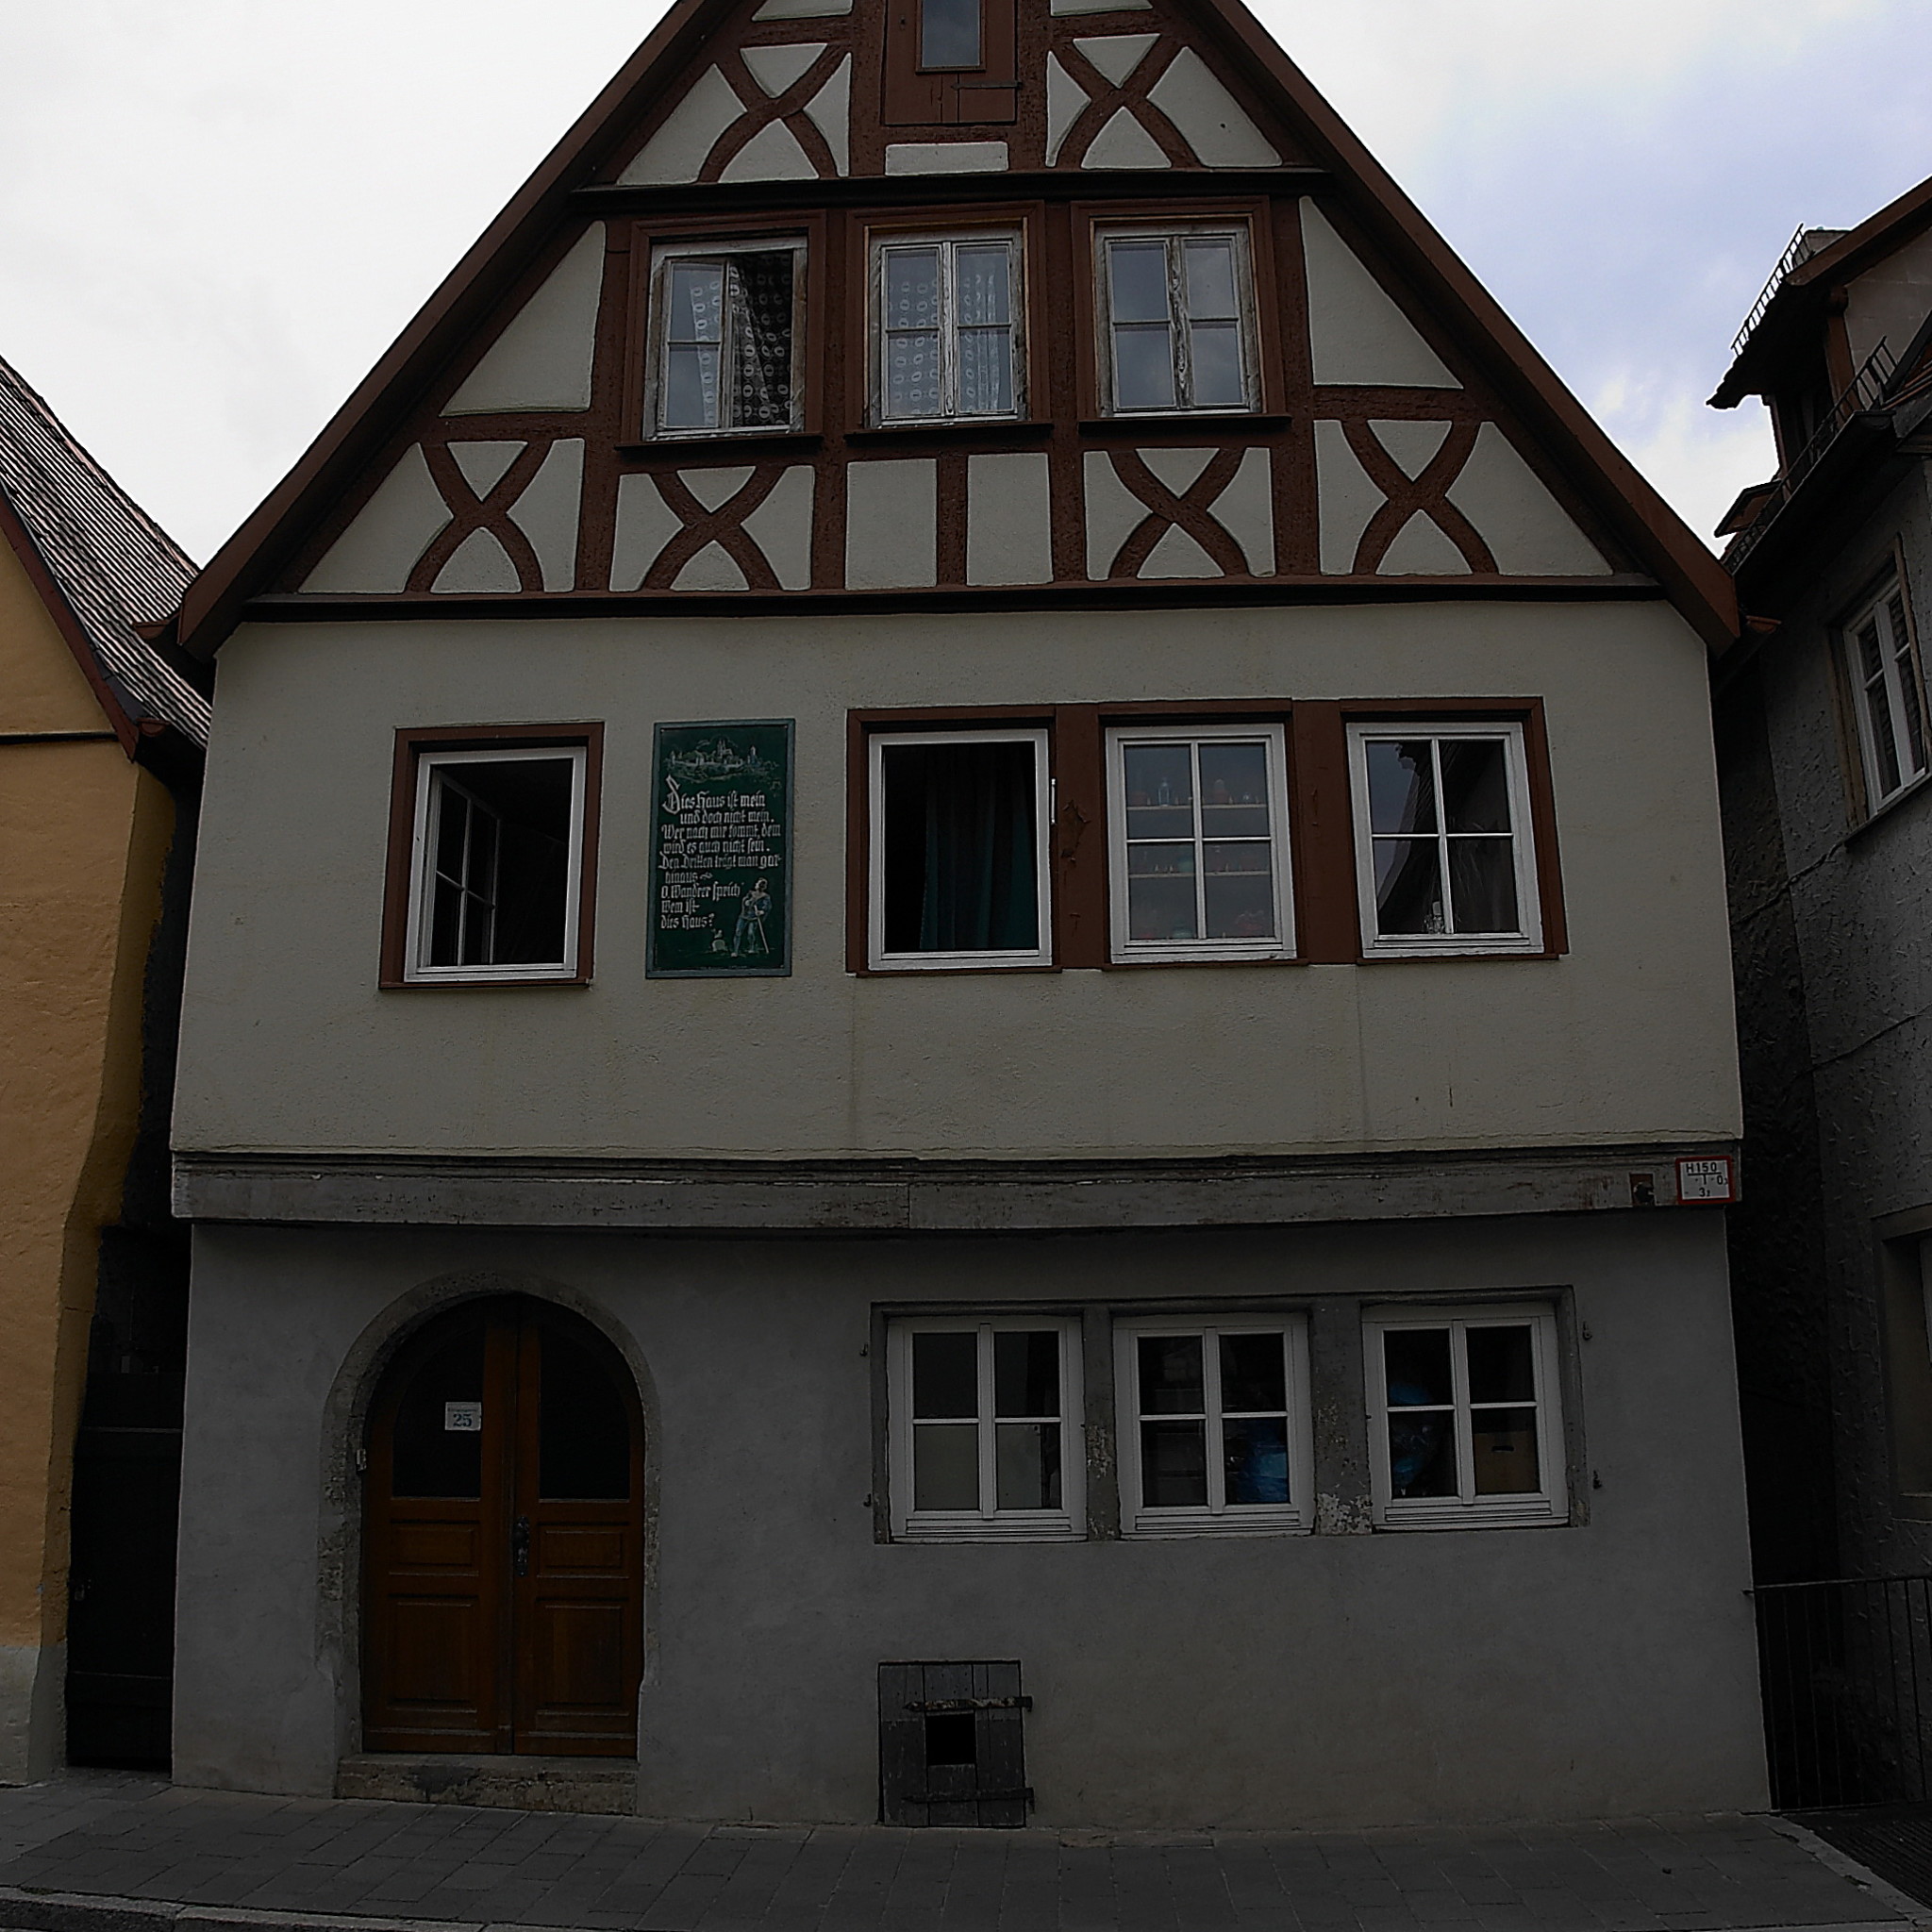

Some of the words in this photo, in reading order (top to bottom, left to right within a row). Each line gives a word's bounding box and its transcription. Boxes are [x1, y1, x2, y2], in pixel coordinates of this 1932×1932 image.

[661, 774, 695, 814] Dies
[696, 791, 724, 809] Haus
[741, 790, 765, 808] mein
[680, 809, 700, 824] und
[702, 809, 722, 824] doch
[724, 809, 746, 824] nicht
[661, 824, 684, 840] Wer
[687, 825, 708, 840] nach
[710, 824, 727, 838] mir
[761, 823, 781, 837] dem
[663, 839, 686, 854] wird
[687, 841, 697, 854] es
[699, 841, 720, 853] auch
[723, 839, 745, 853] nicht
[658, 851, 680, 870] Den
[738, 856, 758, 868] man
[665, 870, 698, 884] hinaus
[661, 900, 683, 913] Wem
[453, 1413, 472, 1426] 25
